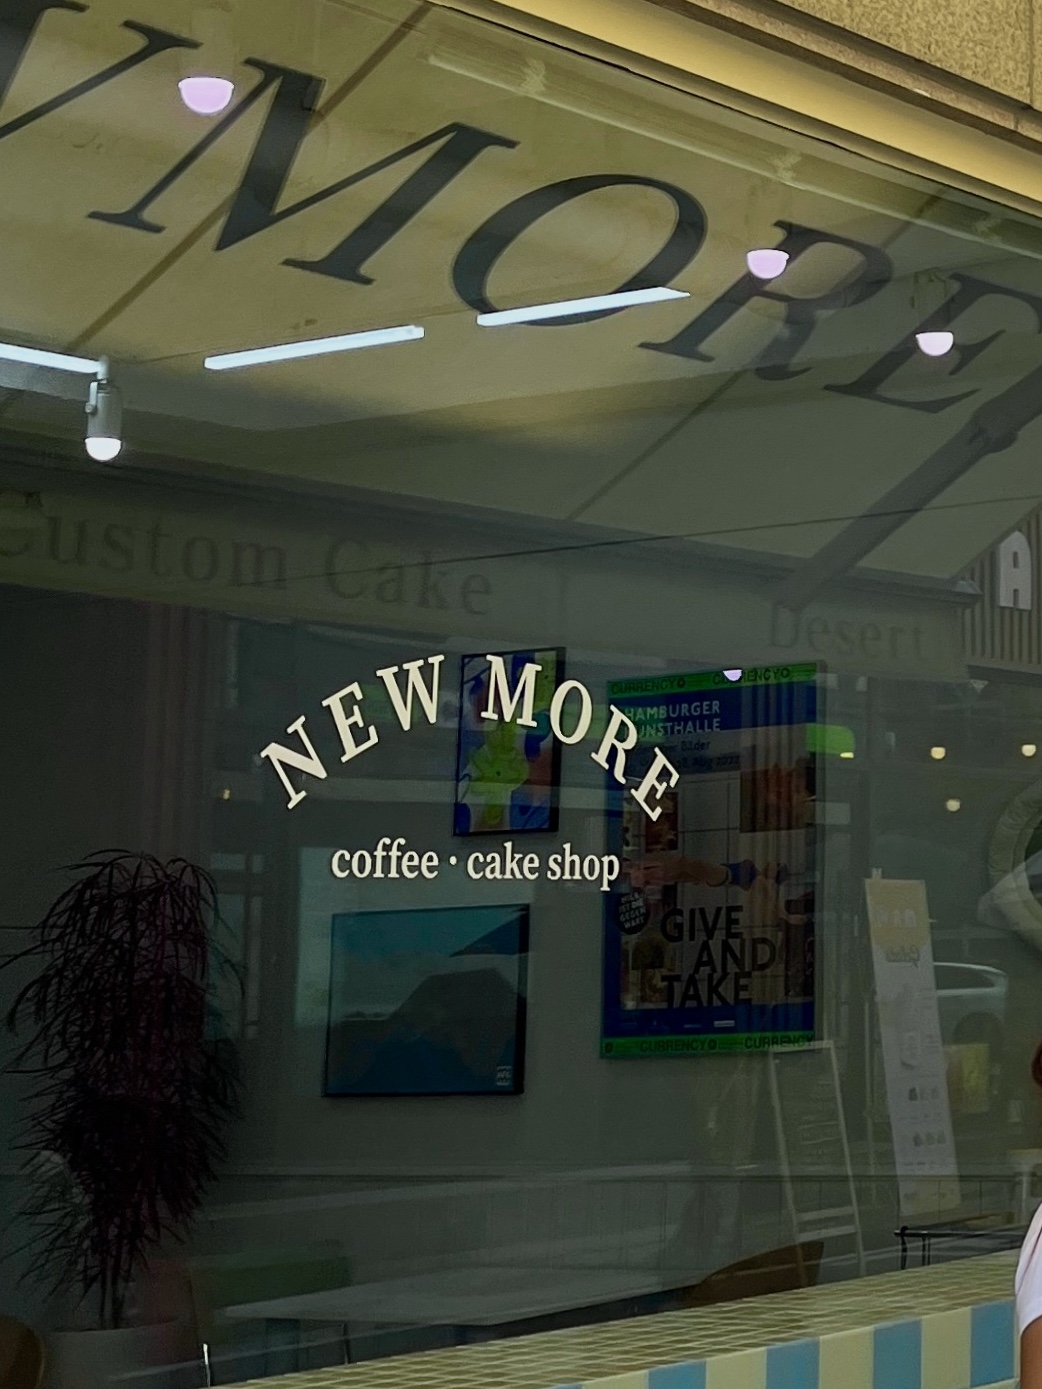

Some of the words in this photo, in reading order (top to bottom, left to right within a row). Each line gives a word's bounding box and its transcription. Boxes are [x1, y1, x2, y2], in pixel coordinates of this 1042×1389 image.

[325, 536, 492, 616] Cake
[624, 700, 721, 722] HAMBURGER
[626, 718, 721, 738] UNSTHALLE
[260, 654, 445, 810] NEW
[480, 654, 681, 823] MORE
[330, 837, 439, 880] coffee
[466, 841, 540, 881] cake
[547, 842, 621, 891] shop
[660, 905, 744, 943] GIVE
[693, 937, 776, 975] AND
[661, 972, 753, 1009] TAKE
